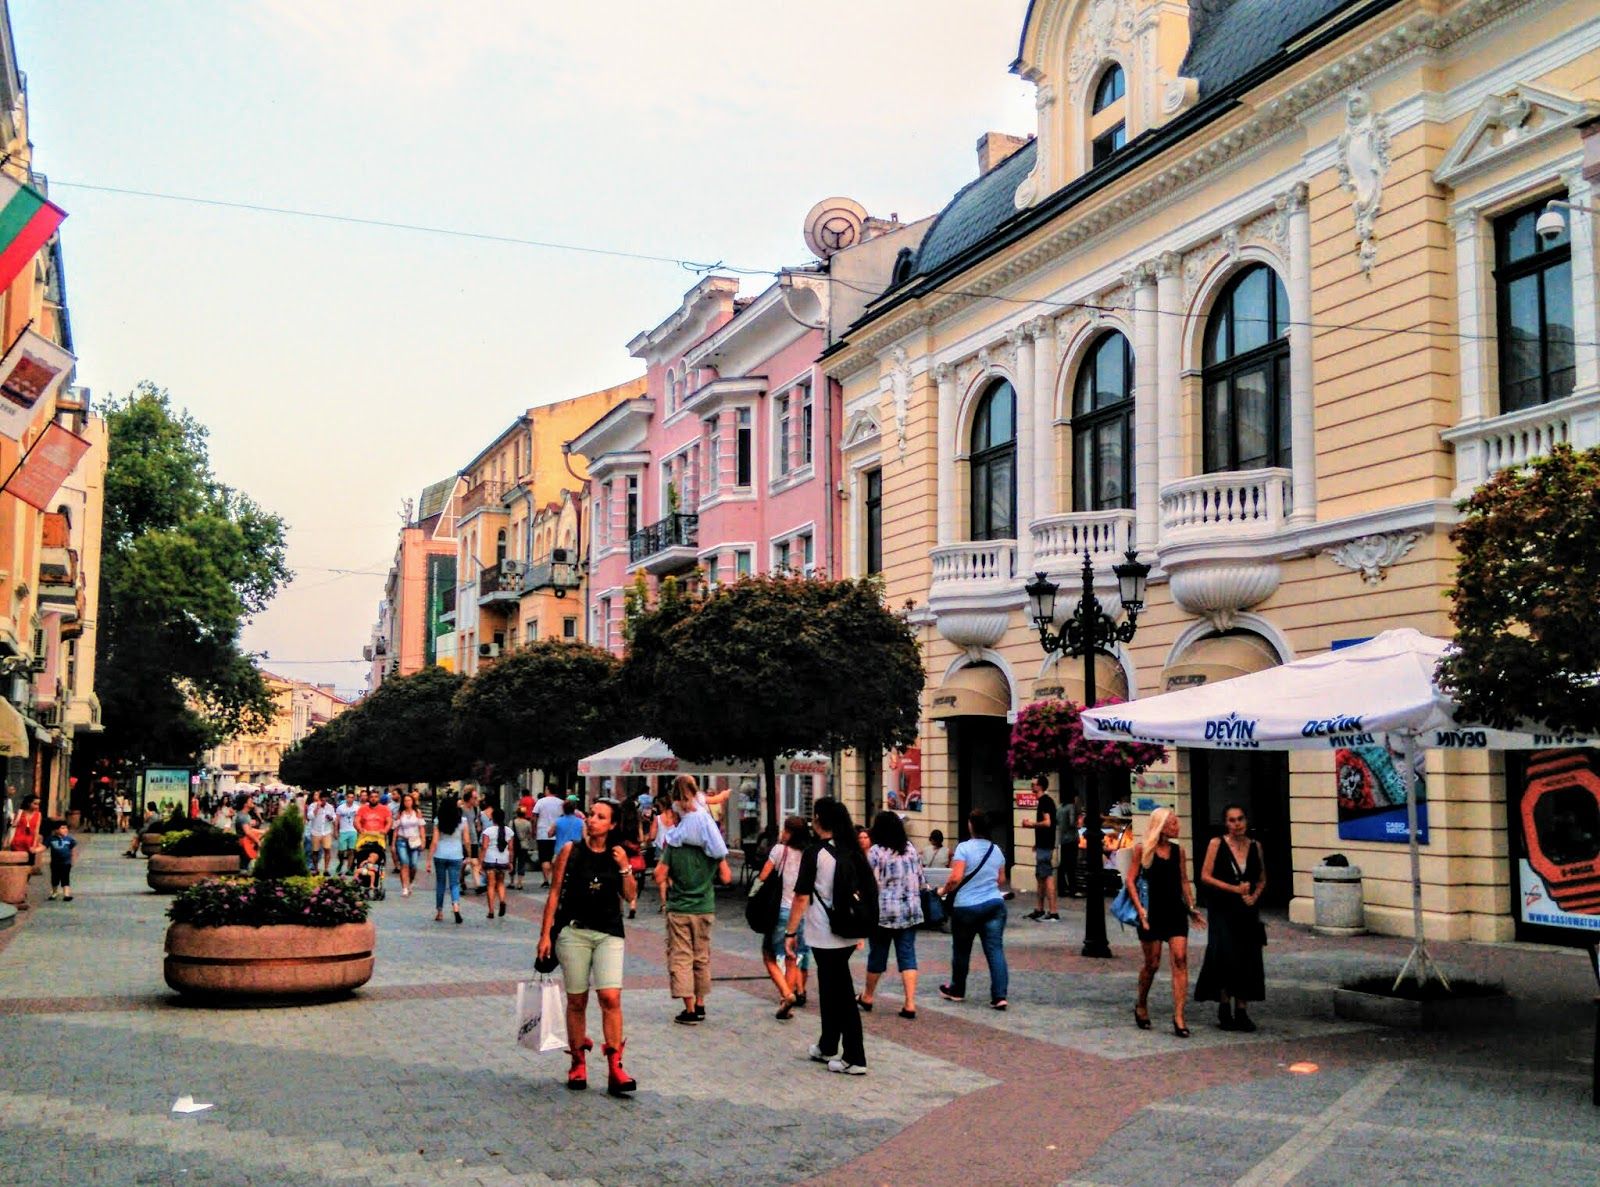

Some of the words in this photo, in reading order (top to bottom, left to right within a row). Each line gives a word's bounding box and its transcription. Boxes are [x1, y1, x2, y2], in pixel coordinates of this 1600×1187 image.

[1204, 714, 1257, 740] DEVIN
[1302, 714, 1363, 737] DEVIN
[640, 757, 679, 772] Coca-Cola
[789, 761, 827, 773] Coca-Cola
